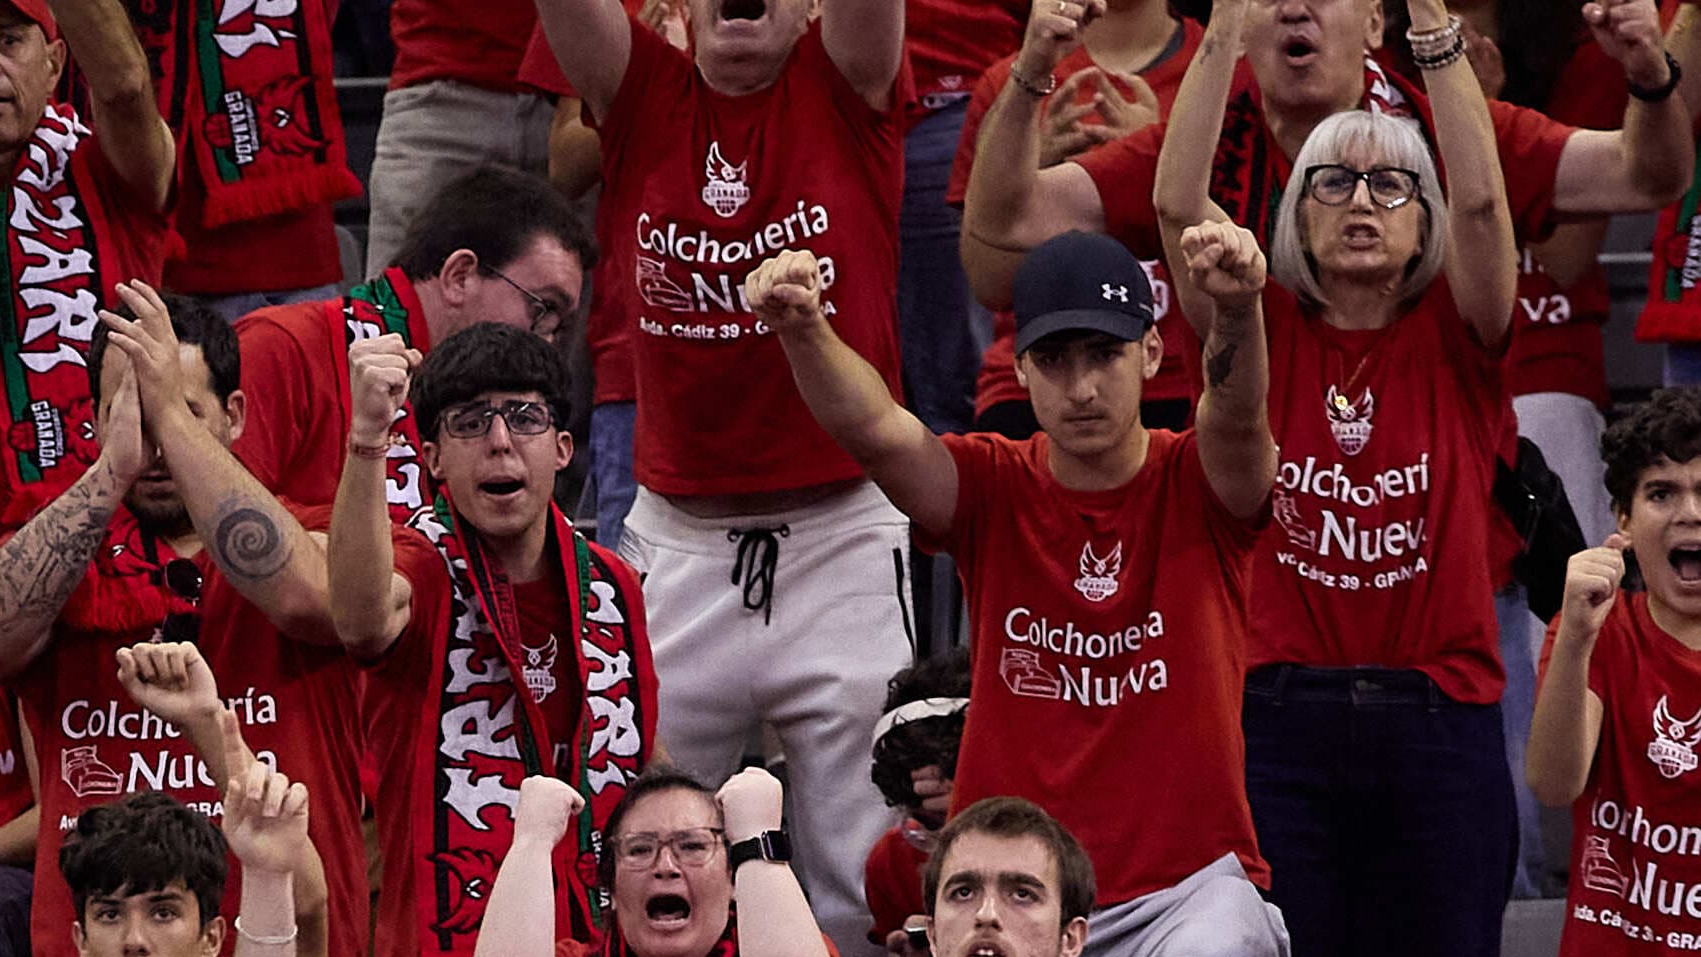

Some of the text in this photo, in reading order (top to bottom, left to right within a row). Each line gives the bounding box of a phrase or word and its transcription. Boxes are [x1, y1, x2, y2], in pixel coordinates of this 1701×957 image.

[718, 324, 740, 340] 39
[30, 400, 56, 468] GRANADA
[1338, 574, 1361, 591] 39
[1058, 658, 1168, 707] Nuva
[61, 687, 277, 741] Colchría
